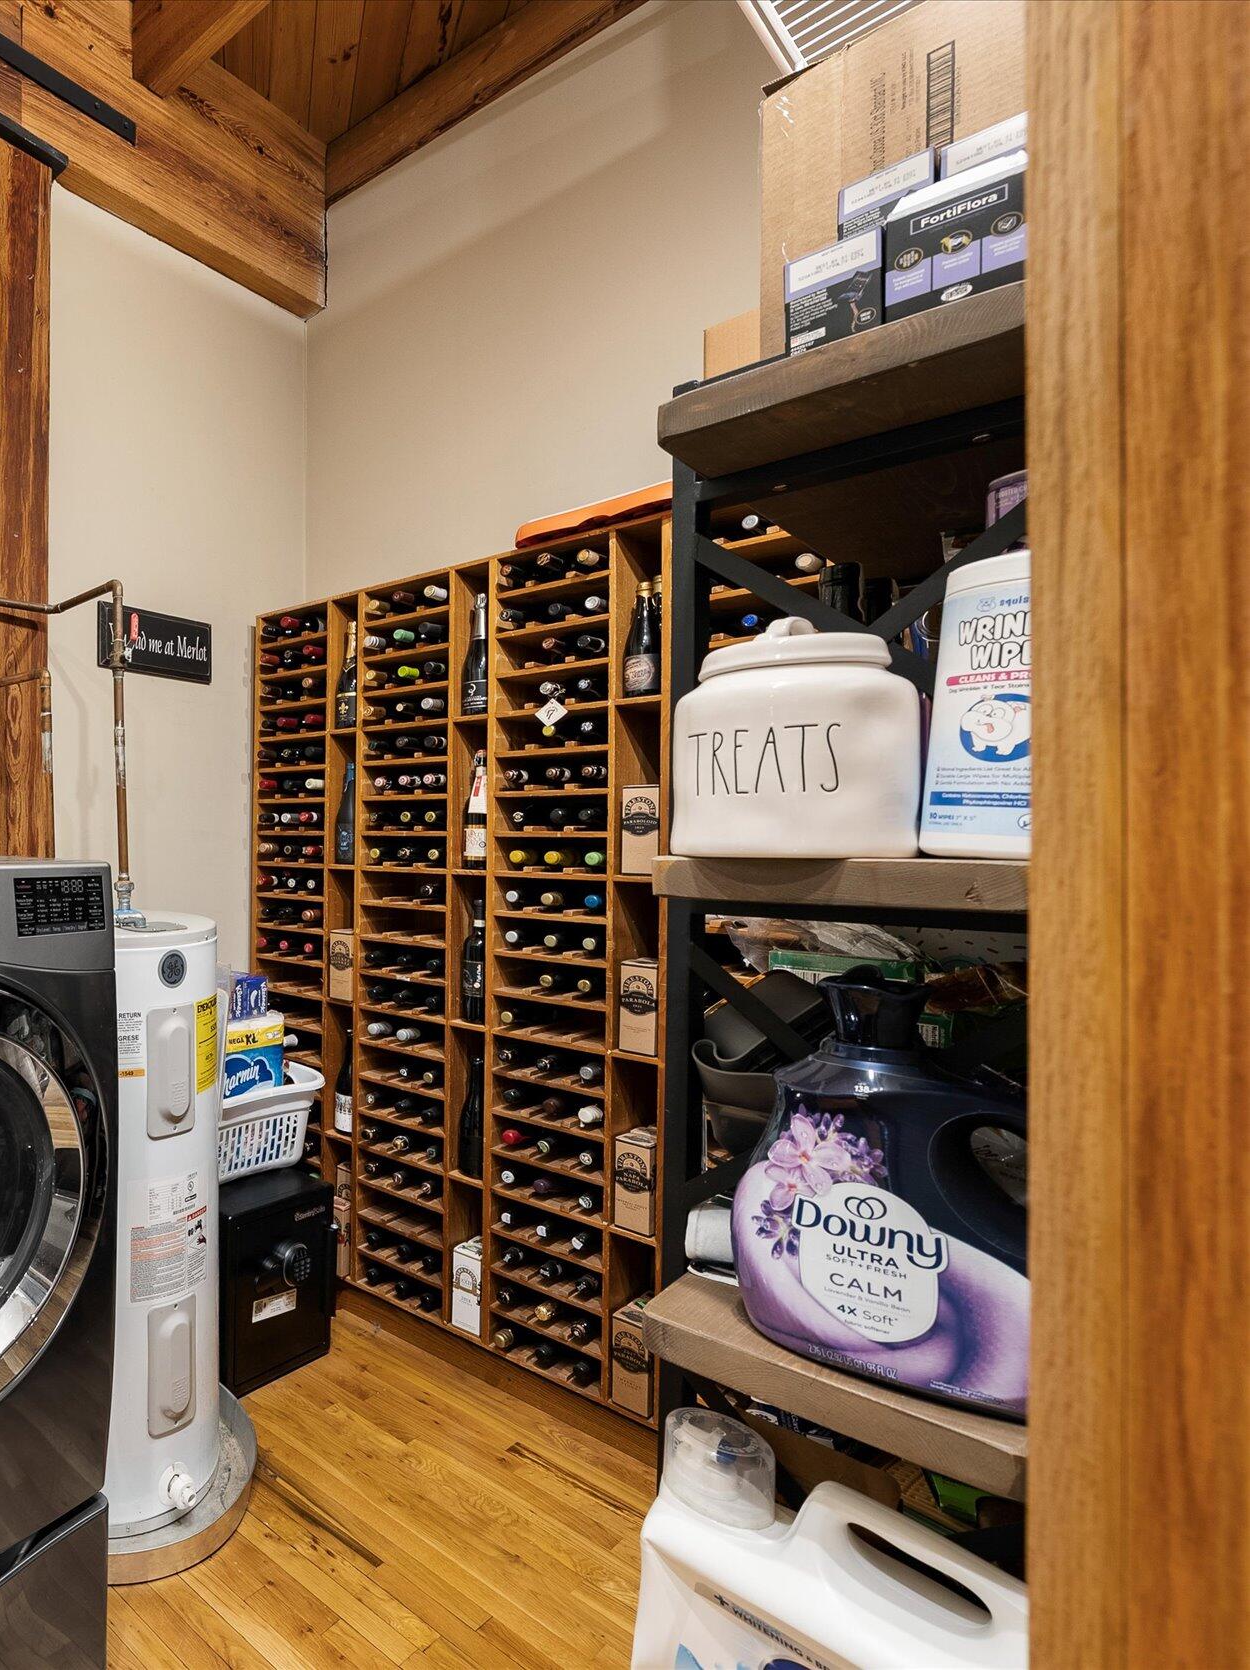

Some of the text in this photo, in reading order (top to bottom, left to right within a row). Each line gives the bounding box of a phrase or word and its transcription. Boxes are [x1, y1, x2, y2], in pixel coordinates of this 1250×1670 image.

[920, 193, 998, 228] FortiFlora
[149, 638, 162, 654] me
[164, 640, 175, 656] at
[176, 635, 208, 662] Merlot
[958, 674, 996, 684] CLEANS
[1010, 670, 1031, 680] PR
[688, 723, 842, 796] TREATS
[621, 997, 655, 1007] PARABOLA
[224, 1064, 260, 1097] harmin
[795, 1197, 943, 1269] Downy
[833, 1243, 900, 1270] ULTRA
[824, 1287, 857, 1299] Lavender
[865, 1297, 889, 1308] Vanilla
[890, 1304, 911, 1313] Bean
[829, 1272, 902, 1302] CALM
[837, 1304, 857, 1317] 4X
[732, 1606, 803, 1657] WHITENING
